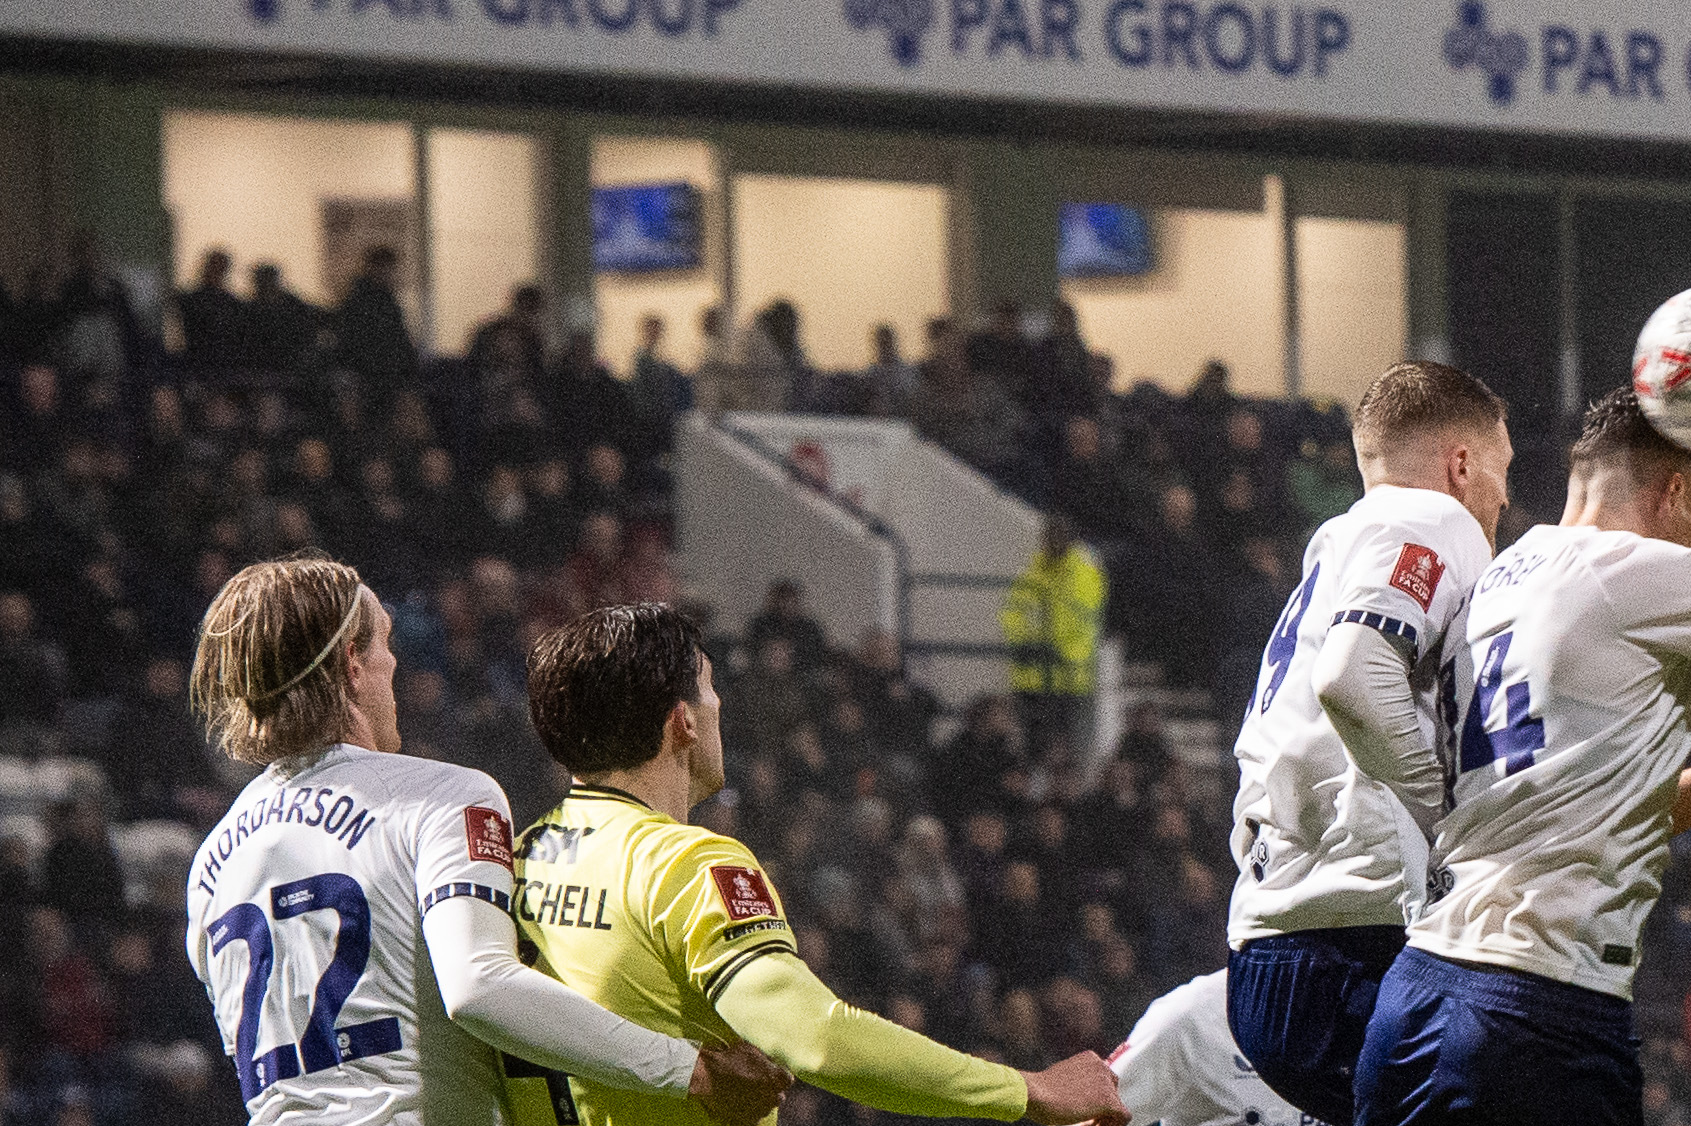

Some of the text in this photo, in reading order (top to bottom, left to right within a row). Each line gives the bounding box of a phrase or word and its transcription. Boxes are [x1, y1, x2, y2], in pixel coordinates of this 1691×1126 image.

[949, 0, 1351, 77] PAR GROUP
[1540, 24, 1666, 99] PAR
[1398, 576, 1429, 601] FA CUP
[197, 787, 377, 899] THORDARSON
[733, 905, 772, 916] FA CUP
[206, 872, 404, 1105] 22
